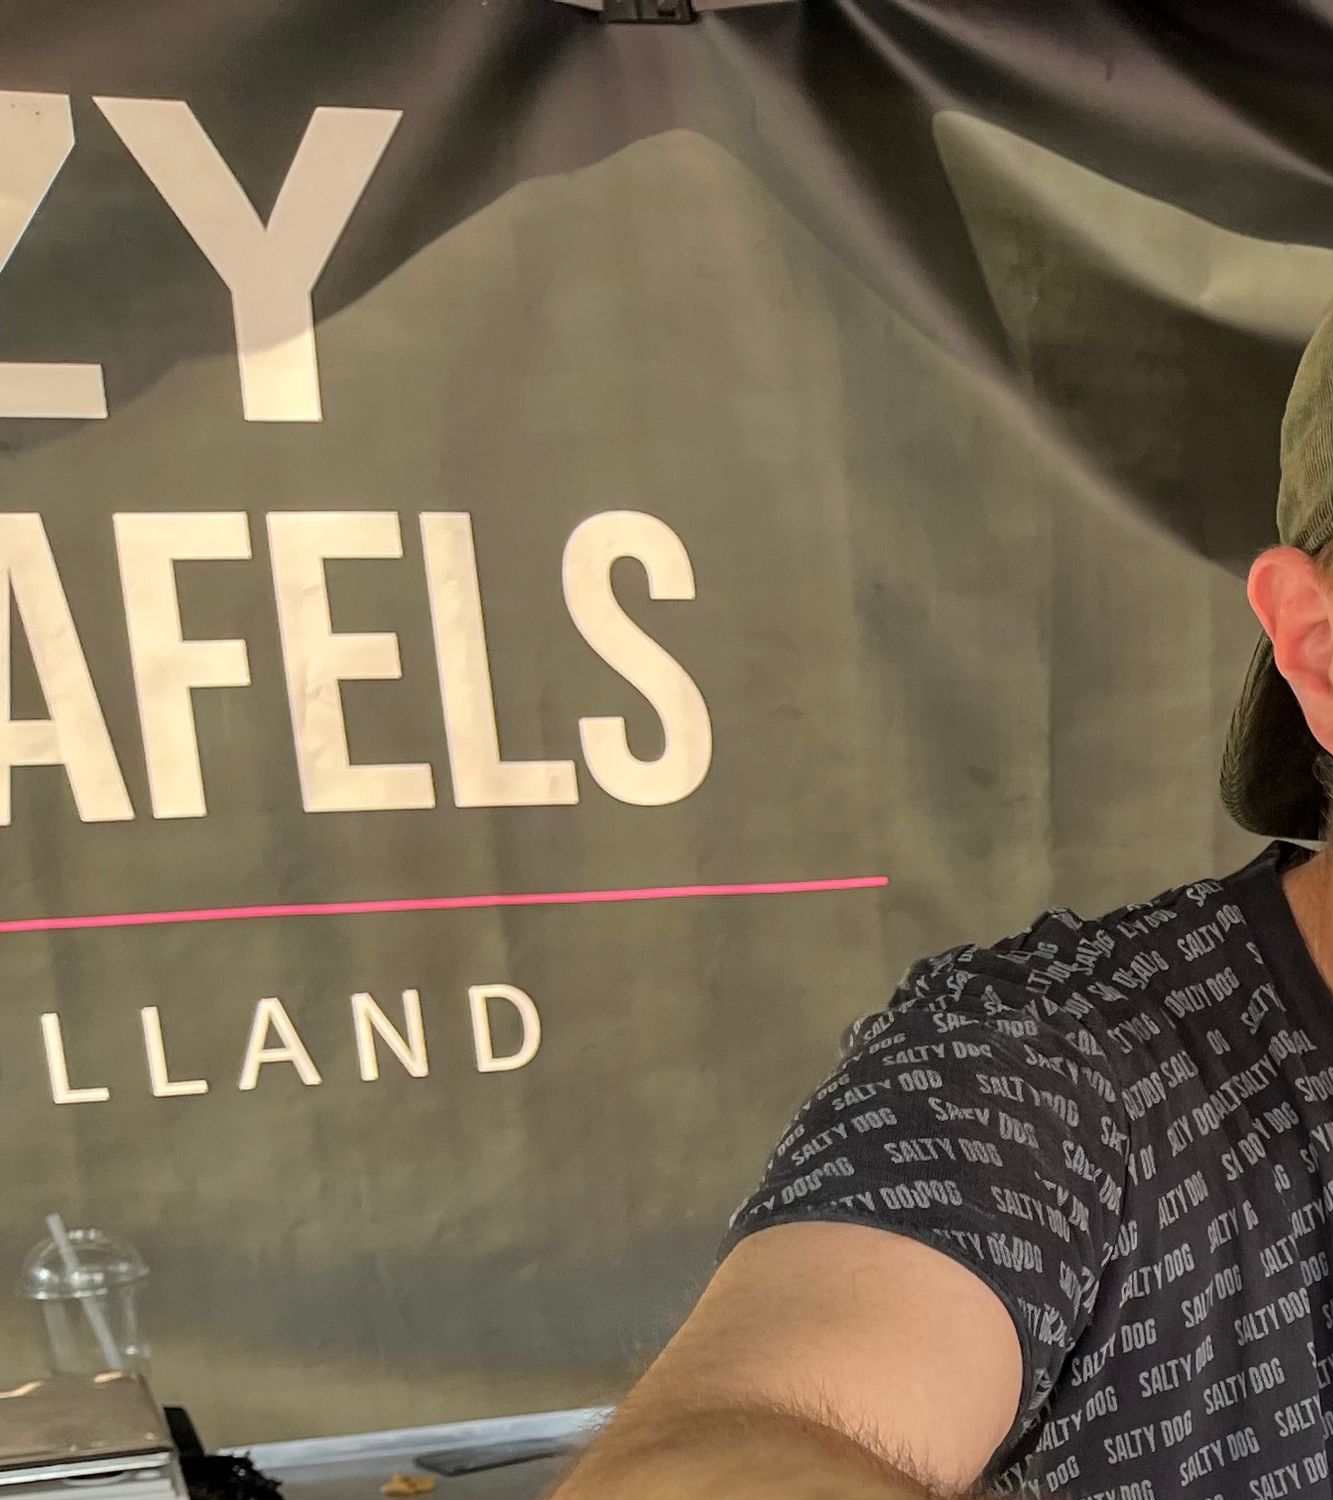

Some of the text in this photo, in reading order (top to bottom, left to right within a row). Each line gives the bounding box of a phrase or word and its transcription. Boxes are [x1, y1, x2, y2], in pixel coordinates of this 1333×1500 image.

[0, 510, 712, 825] AFELS
[41, 984, 541, 1104] LLAND
[883, 1135, 957, 1165] SALTY
[1070, 1317, 1158, 1387] SALTY DOG
[1202, 1356, 1286, 1415] SALTY DOG
[1103, 1409, 1193, 1465] SALTY DOG
[1179, 1426, 1261, 1487] SALTY DOG
